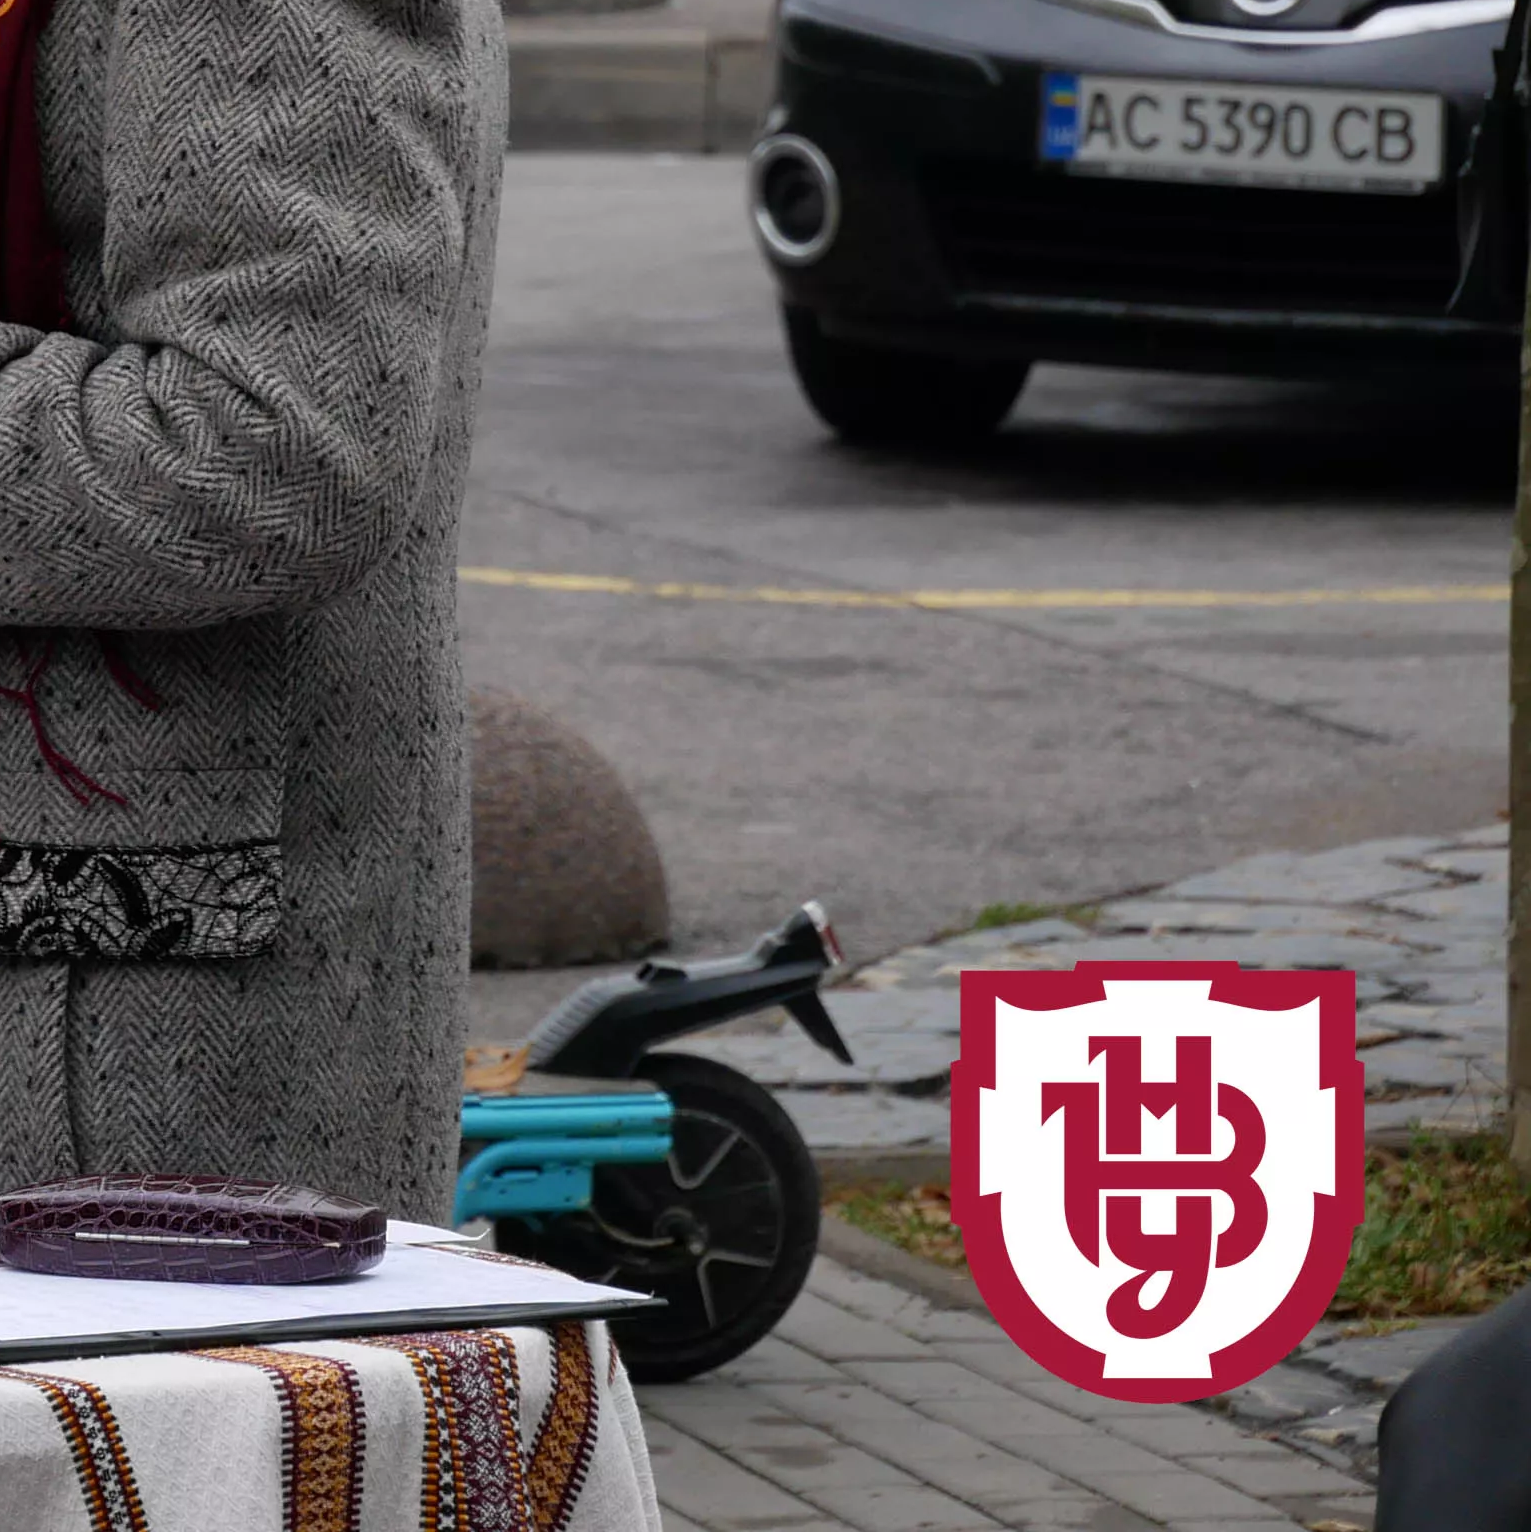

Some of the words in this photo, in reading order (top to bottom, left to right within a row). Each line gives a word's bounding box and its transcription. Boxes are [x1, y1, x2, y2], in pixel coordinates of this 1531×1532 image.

[1082, 92, 1160, 152] AC
[1179, 95, 1314, 159] 5390
[1331, 105, 1417, 165] CB
